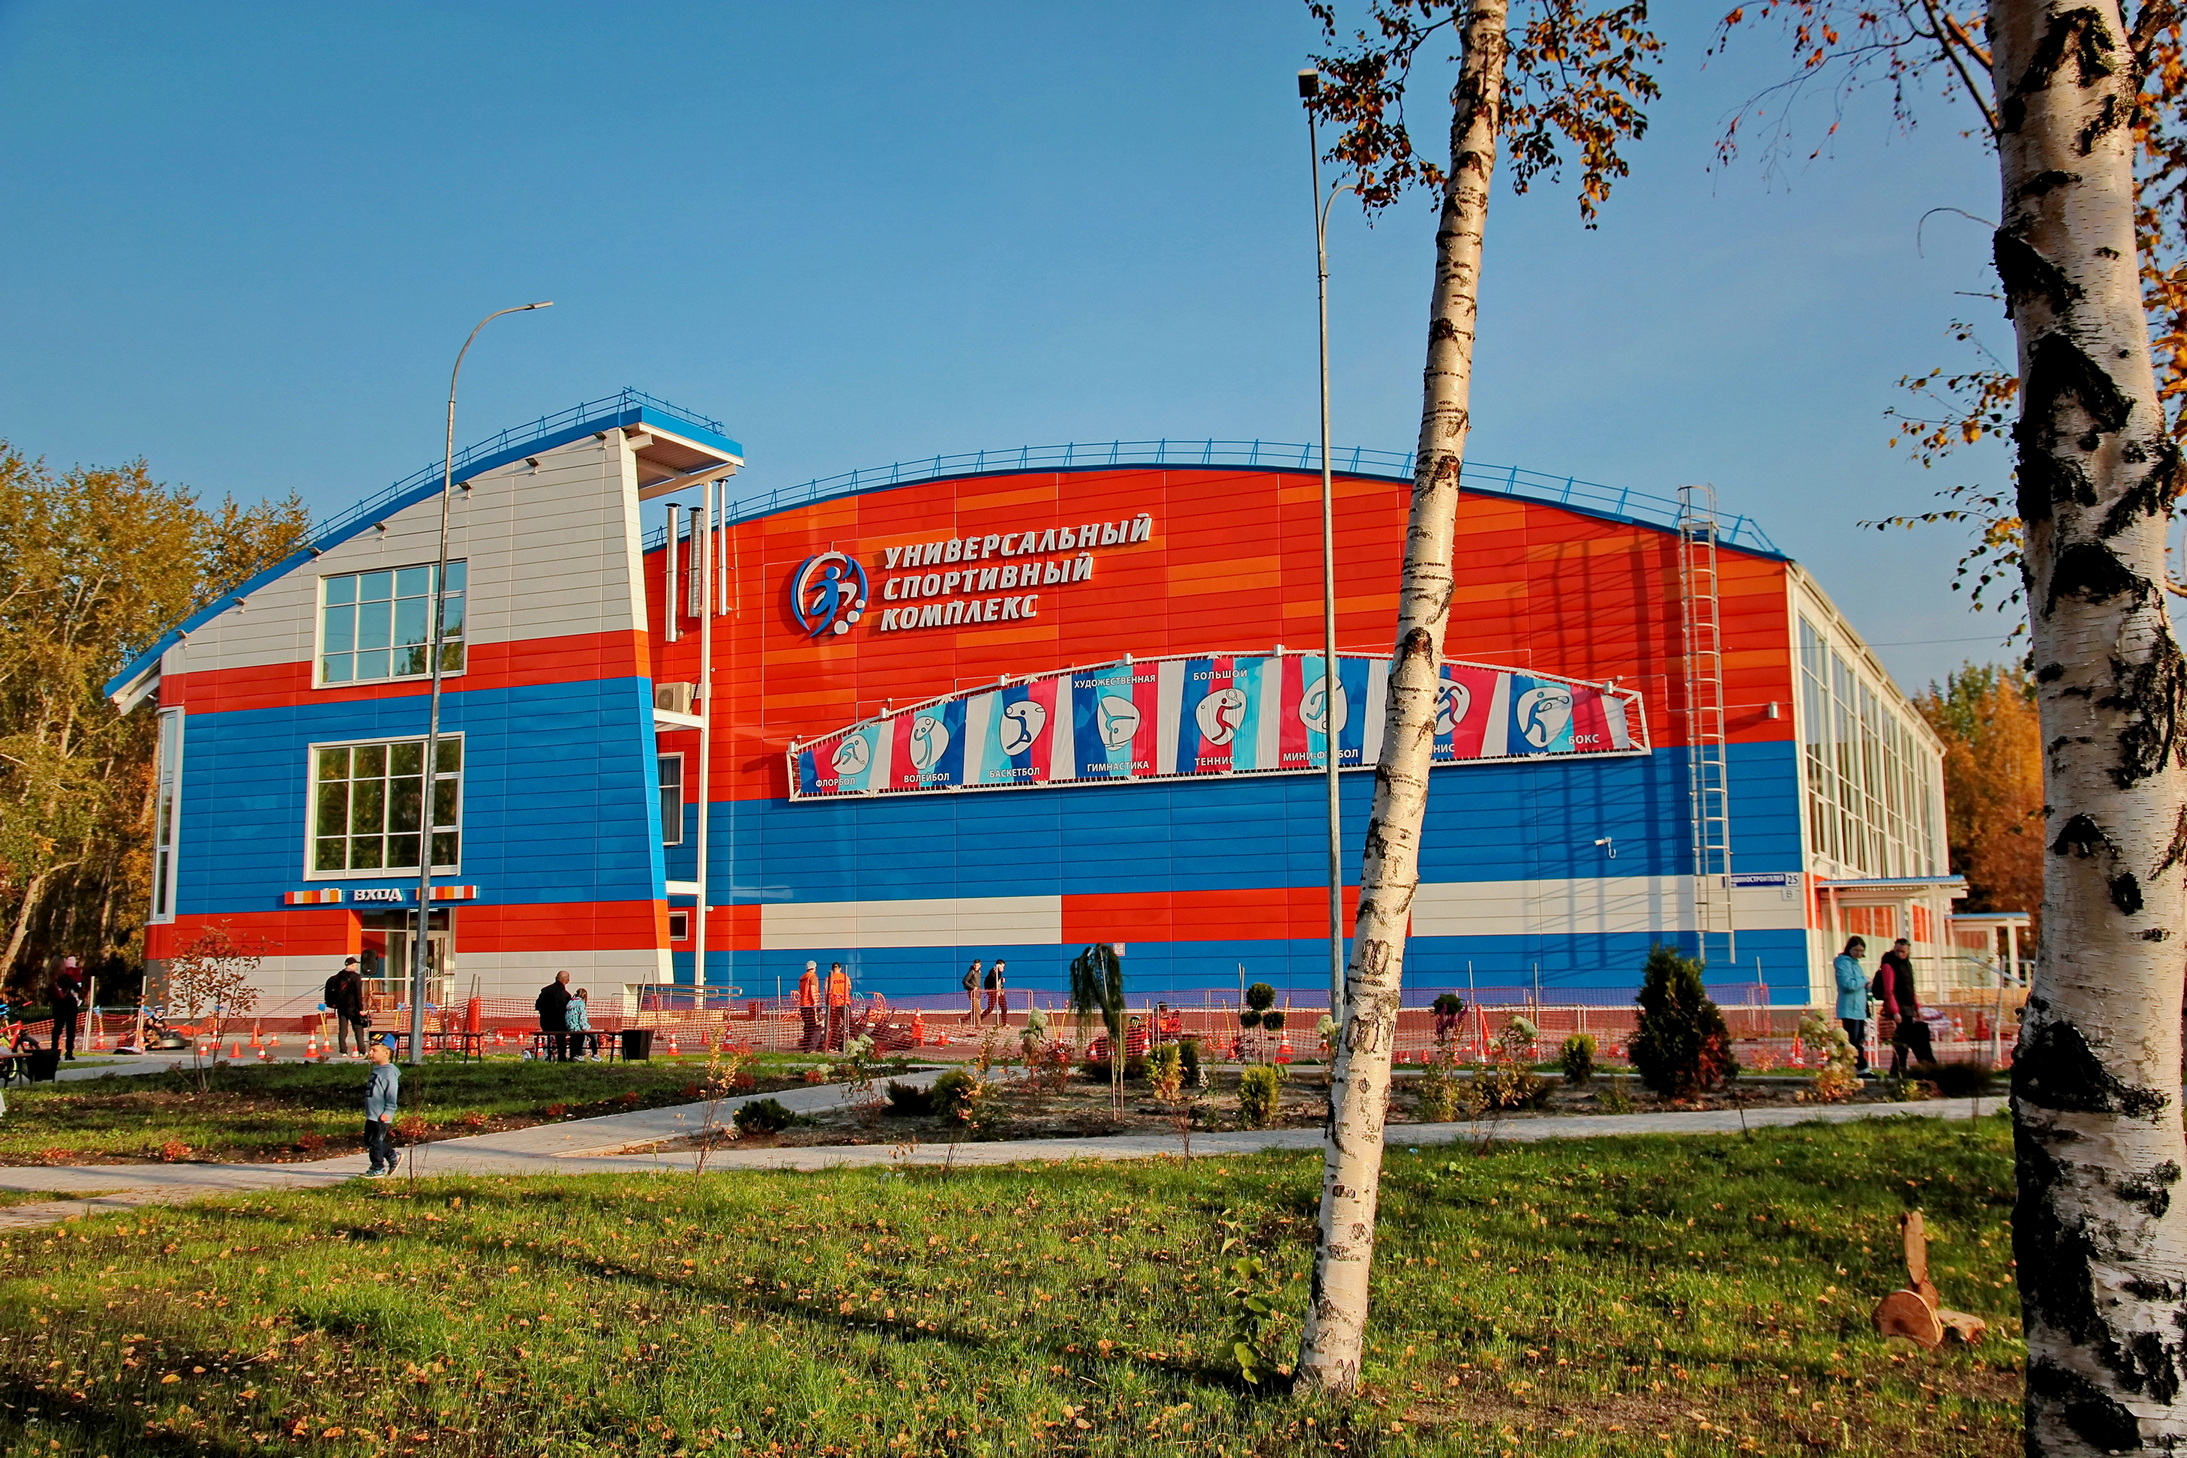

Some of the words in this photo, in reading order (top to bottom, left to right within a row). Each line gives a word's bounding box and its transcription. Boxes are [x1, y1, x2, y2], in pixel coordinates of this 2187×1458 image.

[884, 512, 1153, 569] УНИВЕРСАЛЬНЫЙ
[883, 552, 1094, 601] СПОРТИВНЫЙ
[880, 594, 1039, 631] КОМПЛЕКС
[1193, 667, 1248, 681] БОЛЬШОЙ
[1074, 674, 1156, 689] ХУДОЖЕСТВЕННАЯ
[1568, 733, 1600, 745] БОКС
[1433, 743, 1455, 753] НИС
[1194, 756, 1235, 766] ТЕННИС
[1283, 749, 1359, 762] МИНИ-ФБОЛ
[989, 767, 1040, 778] БАСКЕТБОЛ
[1086, 760, 1149, 773] ГИМНАСТИКА
[815, 777, 856, 788] ФЛОРБОЛ
[903, 772, 950, 783] ВОЛЕЙБОЛ
[1788, 875, 1798, 884] 25
[353, 888, 402, 901] ВХОД
